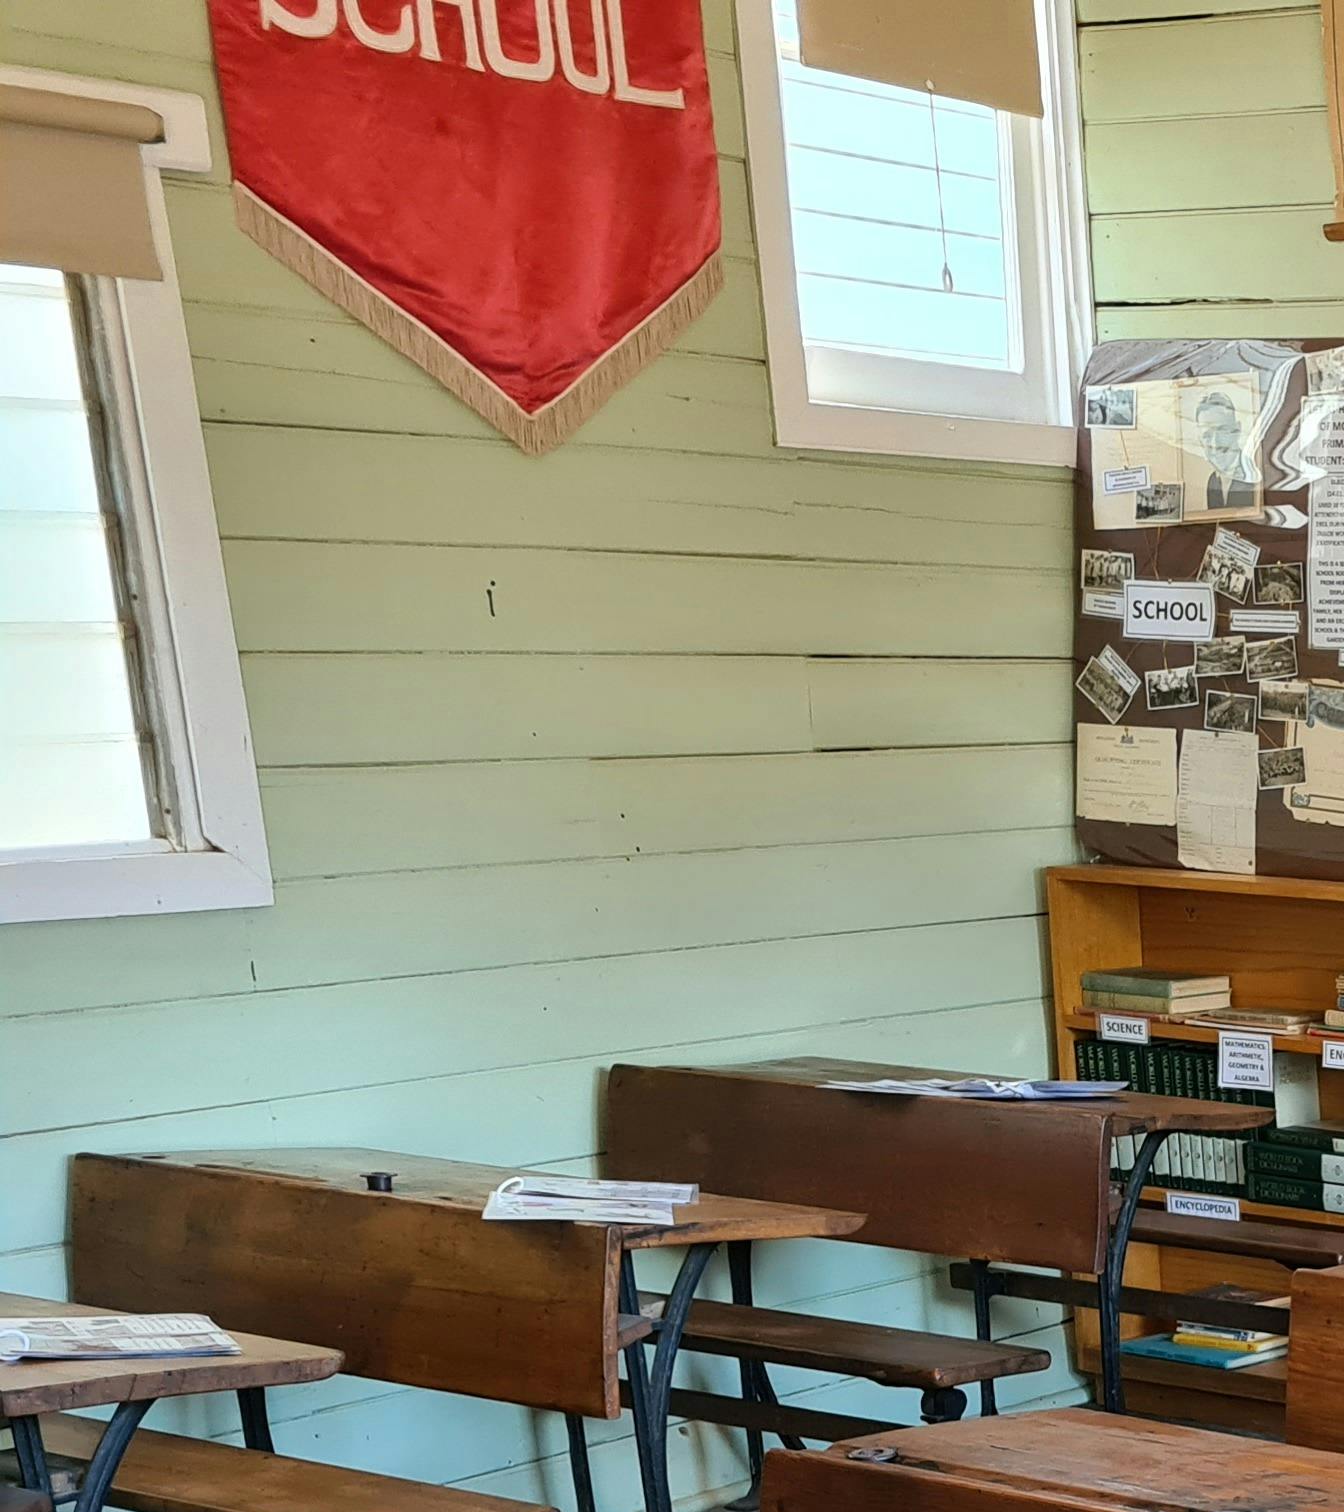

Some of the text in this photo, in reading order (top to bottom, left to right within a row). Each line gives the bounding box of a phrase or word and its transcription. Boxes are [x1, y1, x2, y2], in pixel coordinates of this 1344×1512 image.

[1132, 600, 1208, 622] SCHOOL
[1106, 1022, 1143, 1035] SCIENCE
[1174, 1200, 1233, 1215] ENCYCLOPEDIA
